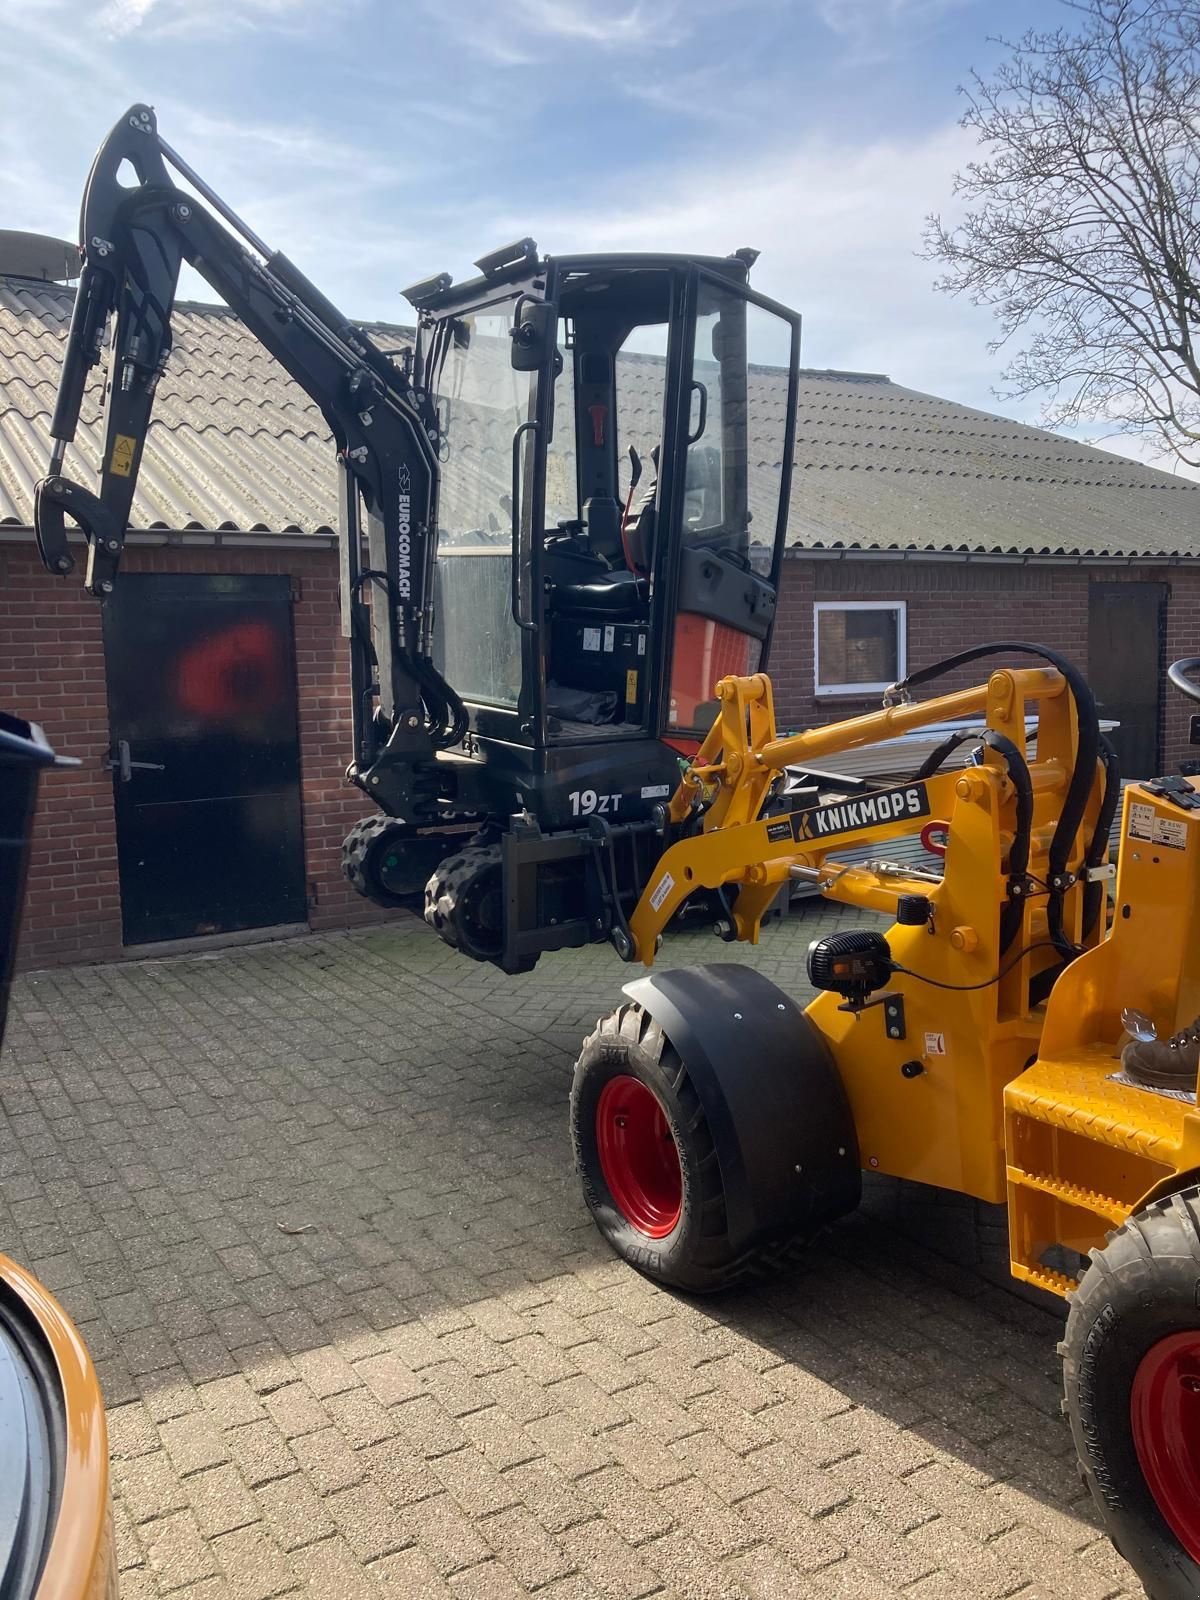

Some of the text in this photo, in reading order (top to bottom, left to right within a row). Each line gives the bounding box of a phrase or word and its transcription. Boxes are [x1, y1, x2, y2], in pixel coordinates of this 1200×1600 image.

[399, 494, 411, 598] EUROCOMACH
[568, 789, 623, 816] 19ZT
[815, 788, 922, 834] KNIKMOPS
